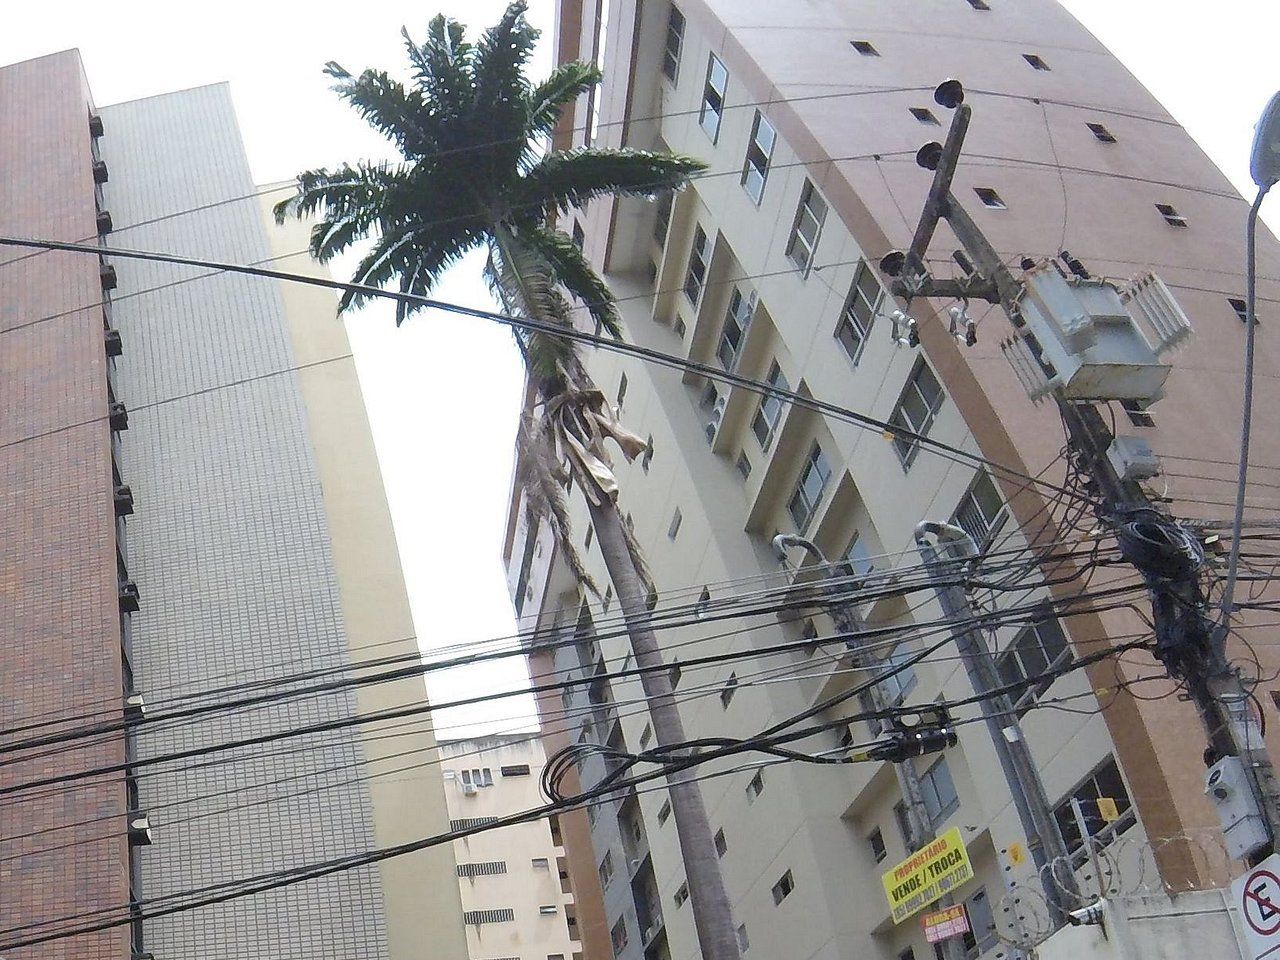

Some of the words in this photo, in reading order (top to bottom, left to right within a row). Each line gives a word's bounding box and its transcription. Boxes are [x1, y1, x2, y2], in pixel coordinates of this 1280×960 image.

[891, 874, 922, 902] VENDE
[927, 848, 963, 878] TROCA
[894, 839, 948, 881] PROPRIETÁRIO
